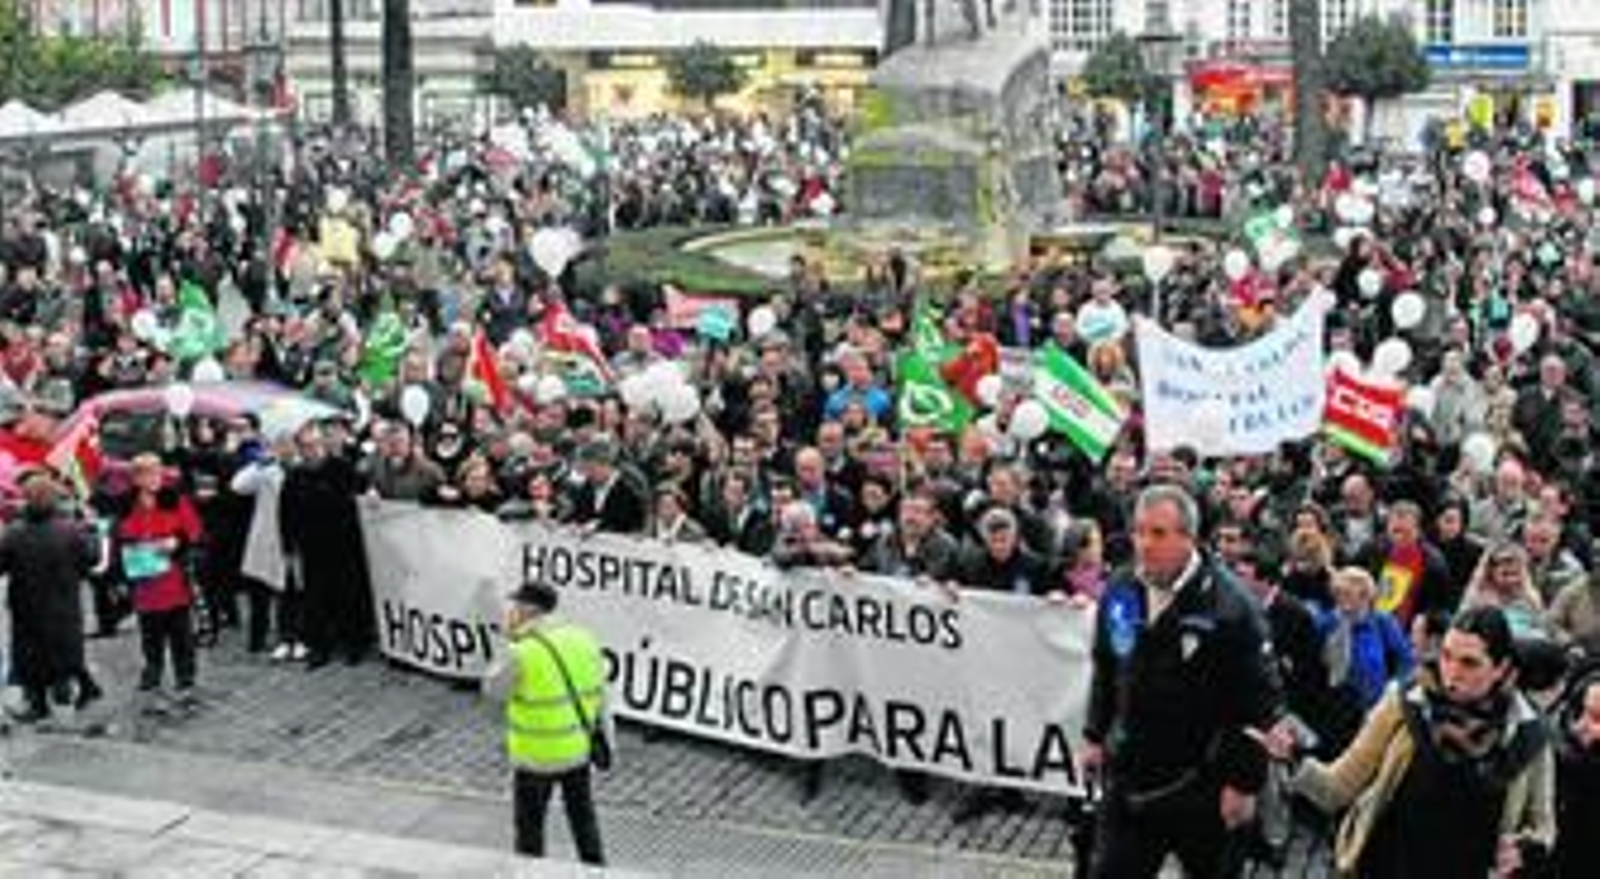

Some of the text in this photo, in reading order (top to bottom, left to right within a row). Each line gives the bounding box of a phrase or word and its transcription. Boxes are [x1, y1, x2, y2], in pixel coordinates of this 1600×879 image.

[522, 543, 702, 606] HOSPITAL
[801, 590, 962, 649] CARLOS
[384, 600, 500, 668] HOSPI
[805, 690, 973, 771] PARA
[993, 717, 1077, 786] LA
